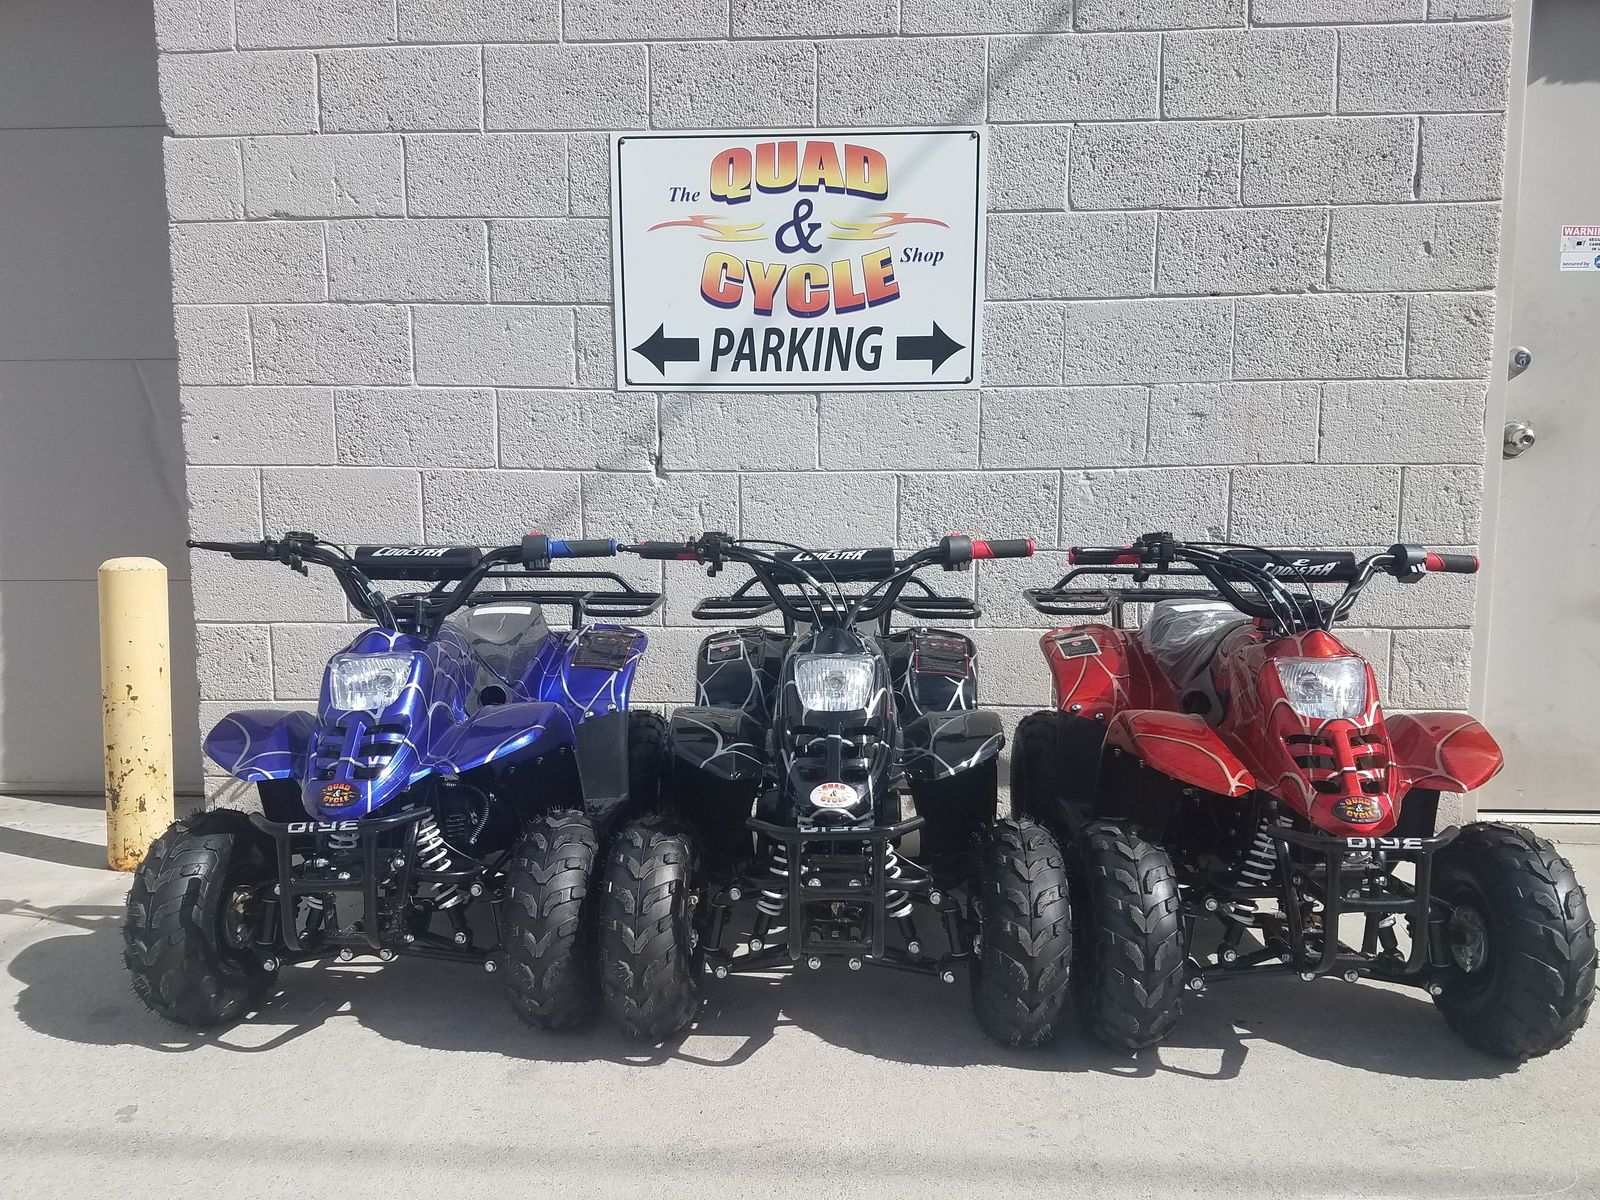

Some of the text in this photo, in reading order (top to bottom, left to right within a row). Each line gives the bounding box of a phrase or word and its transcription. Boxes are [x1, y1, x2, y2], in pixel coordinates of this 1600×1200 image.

[669, 141, 888, 204] The QUAD
[775, 199, 822, 254] &
[700, 247, 944, 318] CYCLE Shop
[710, 326, 884, 373] PARKING
[323, 795, 349, 803] CYCLE
[333, 789, 341, 797] &
[1345, 797, 1371, 806] QUAD
[1355, 804, 1364, 812] &
